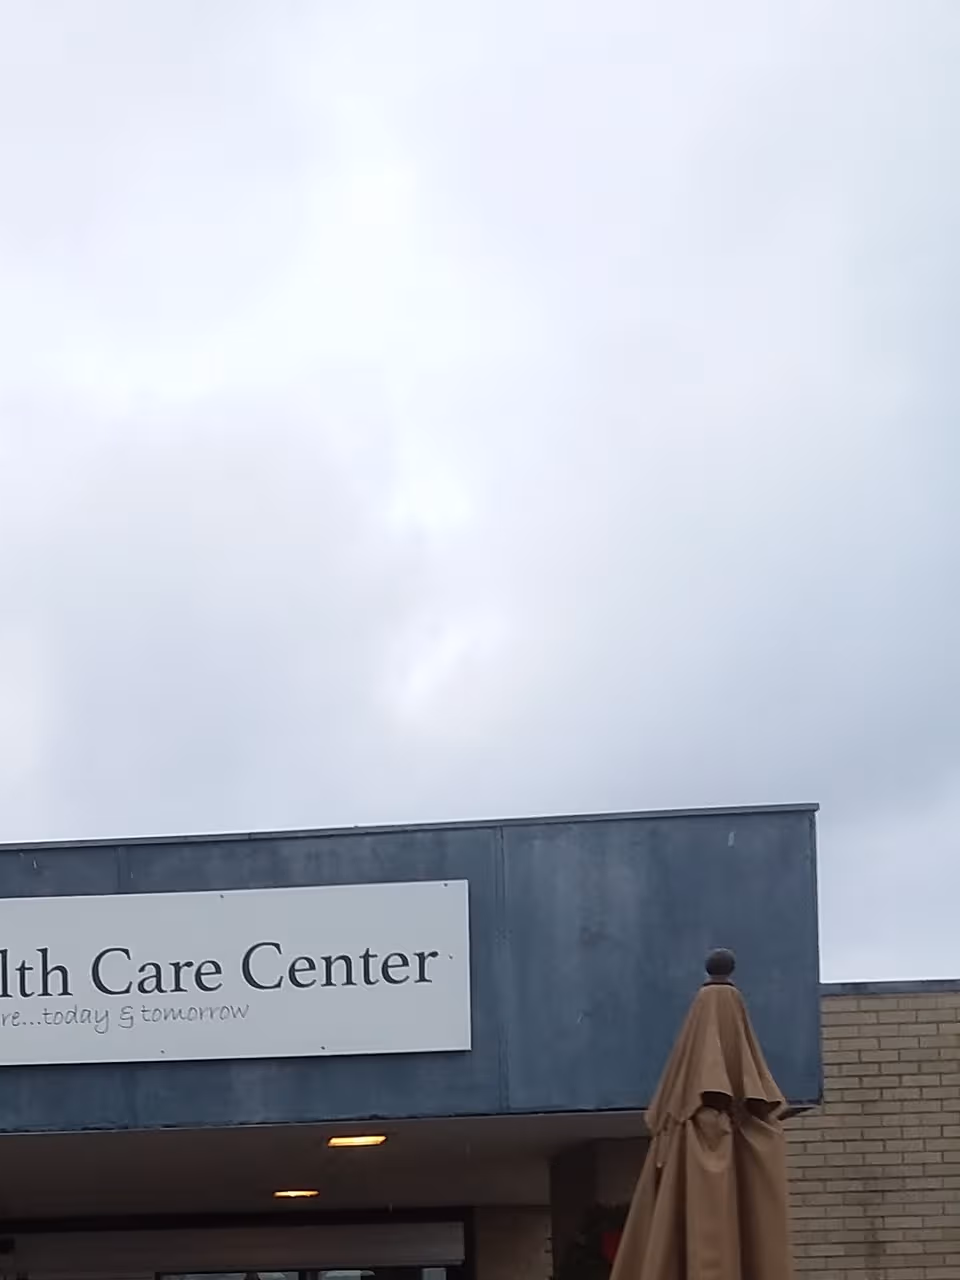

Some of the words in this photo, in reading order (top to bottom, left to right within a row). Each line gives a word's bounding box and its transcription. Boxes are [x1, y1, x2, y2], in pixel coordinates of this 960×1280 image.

[91, 947, 223, 996] Care
[241, 941, 438, 990] Center
[119, 1006, 135, 1029] &
[141, 1004, 250, 1023] tomorrow
